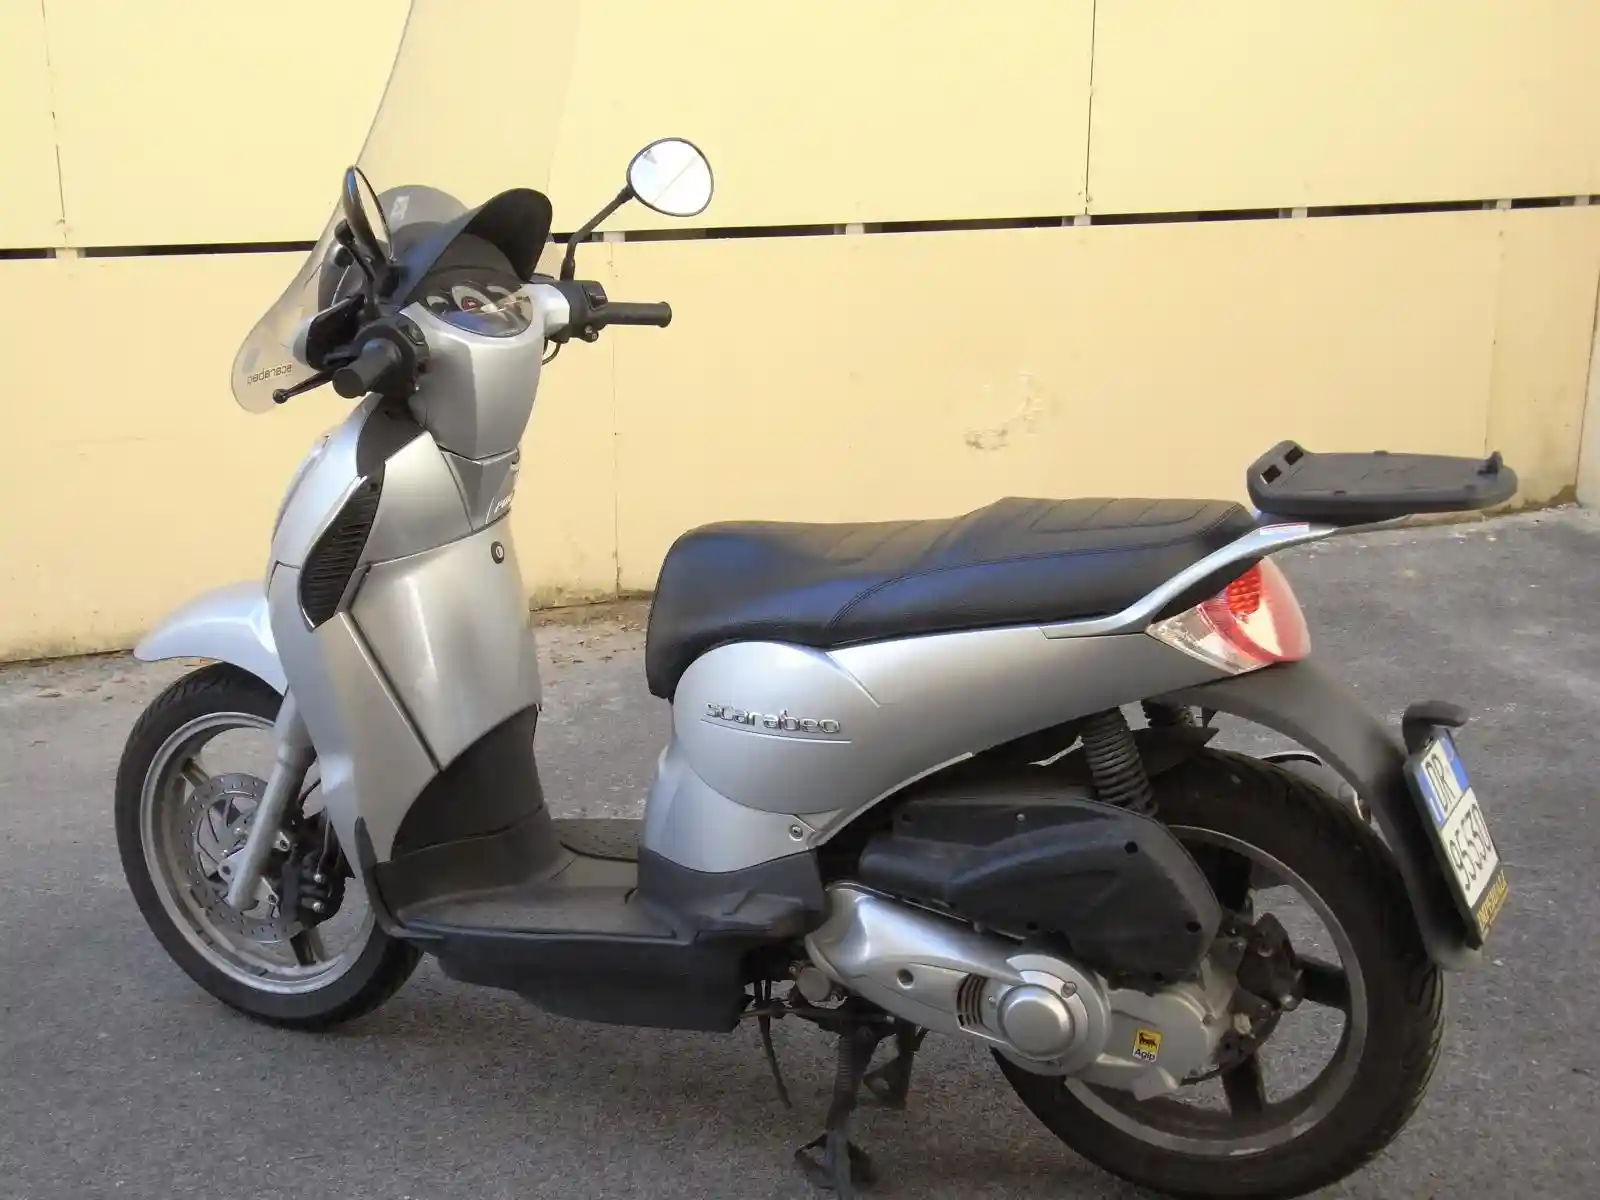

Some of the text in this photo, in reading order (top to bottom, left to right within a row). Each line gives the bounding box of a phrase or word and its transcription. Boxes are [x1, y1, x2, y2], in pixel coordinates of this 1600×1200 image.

[704, 702, 841, 734] scarabeo
[1425, 753, 1456, 812] DR
[1449, 803, 1492, 892] 95530
[1134, 1048, 1156, 1061] Agip
